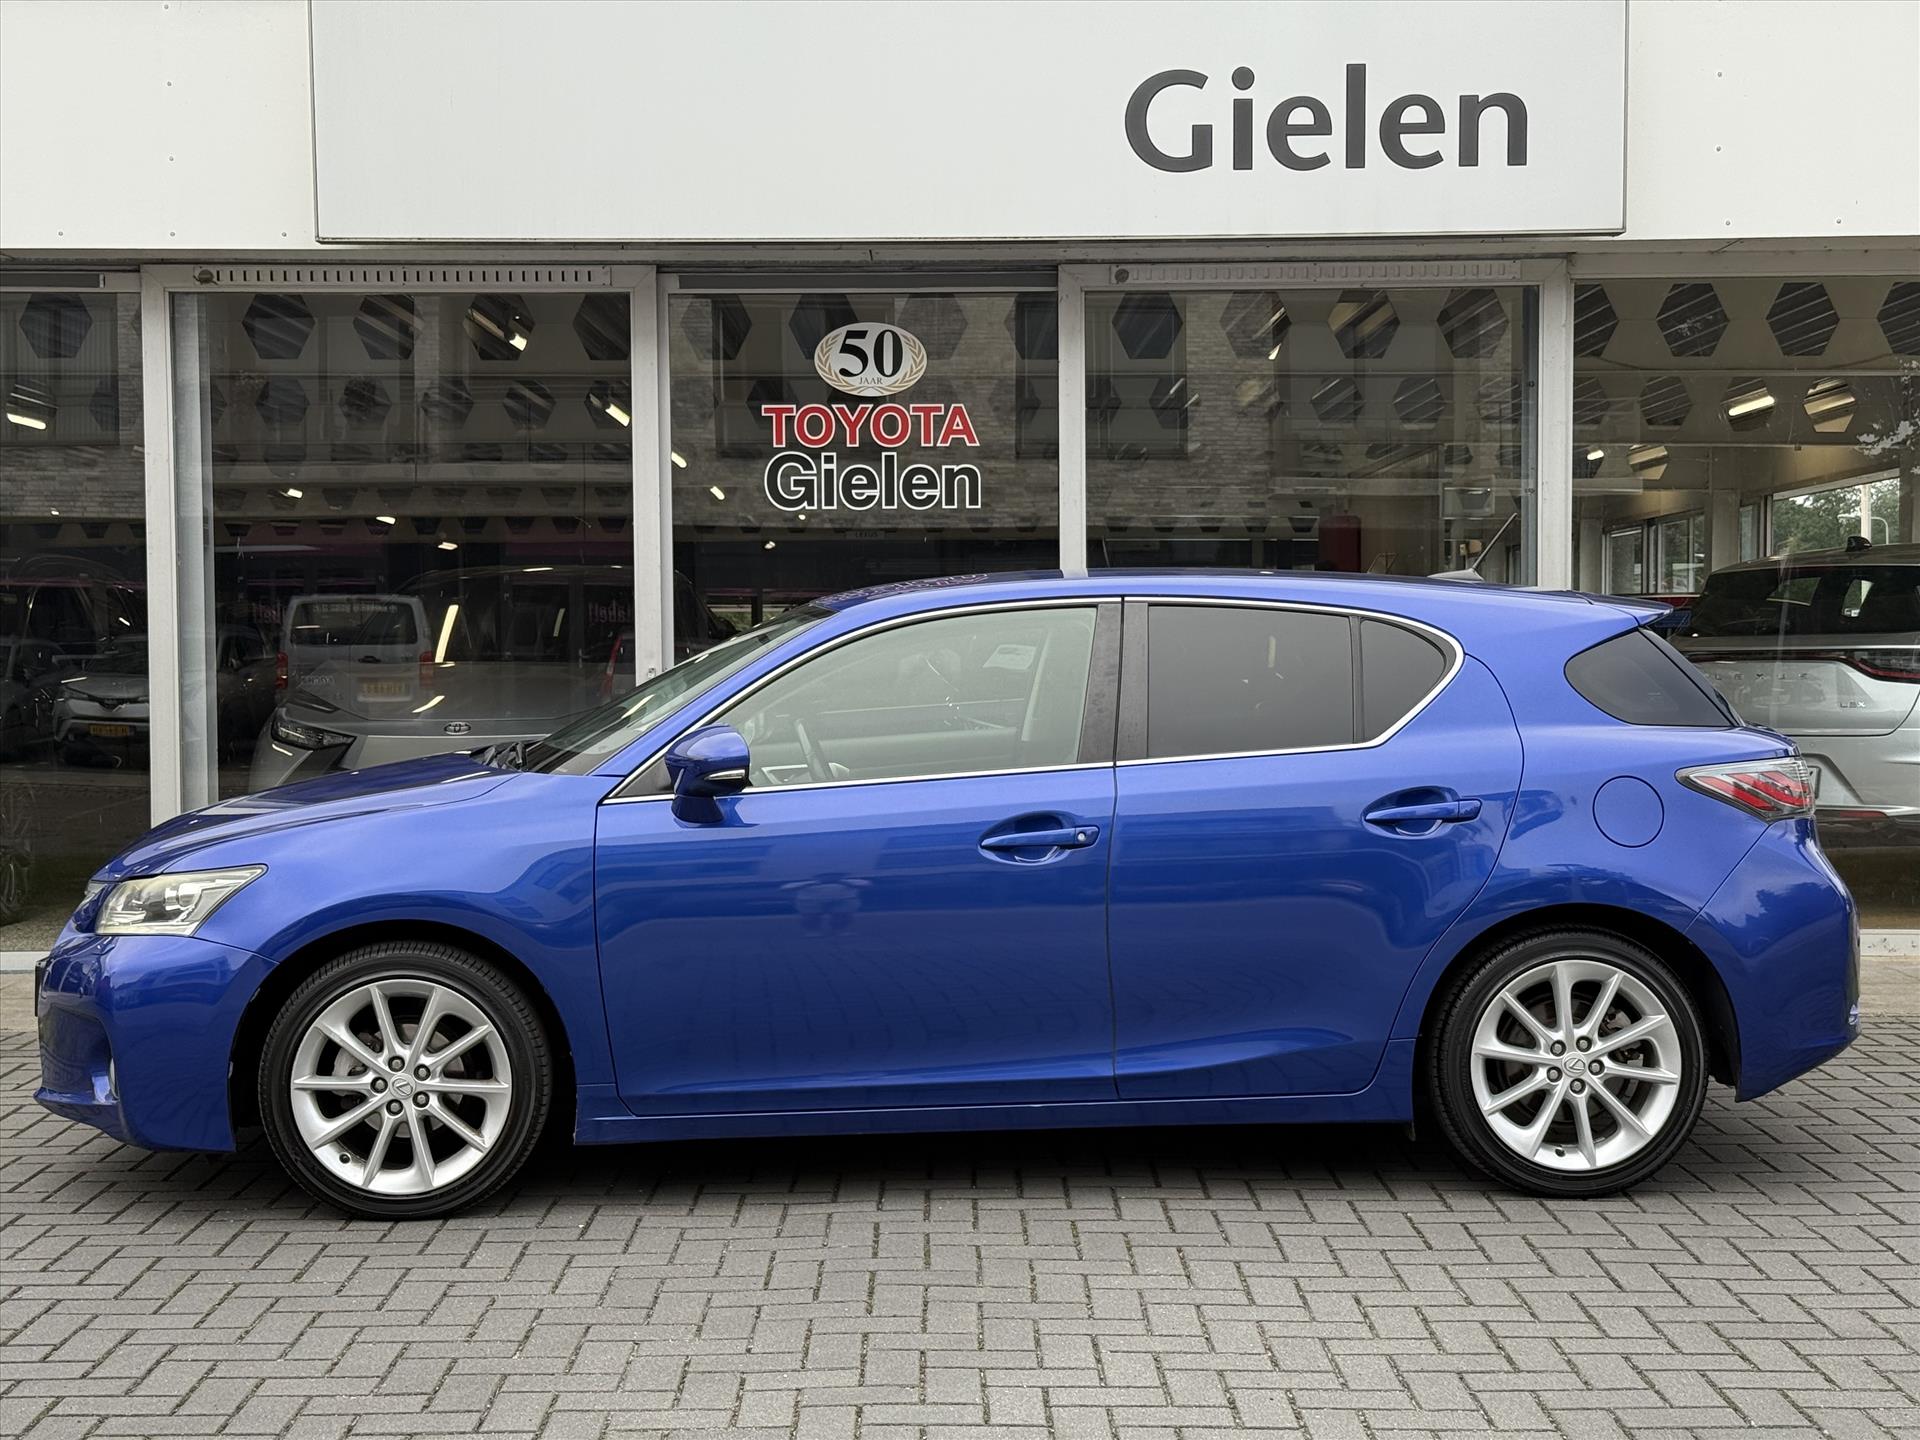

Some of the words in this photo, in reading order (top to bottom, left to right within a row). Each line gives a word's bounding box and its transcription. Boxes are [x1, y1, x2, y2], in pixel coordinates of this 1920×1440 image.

[1125, 63, 1528, 173] Gielen
[839, 329, 904, 377] 50
[859, 377, 883, 385] JAAR
[761, 403, 980, 448] TOYOTA
[764, 451, 982, 511] Gielen
